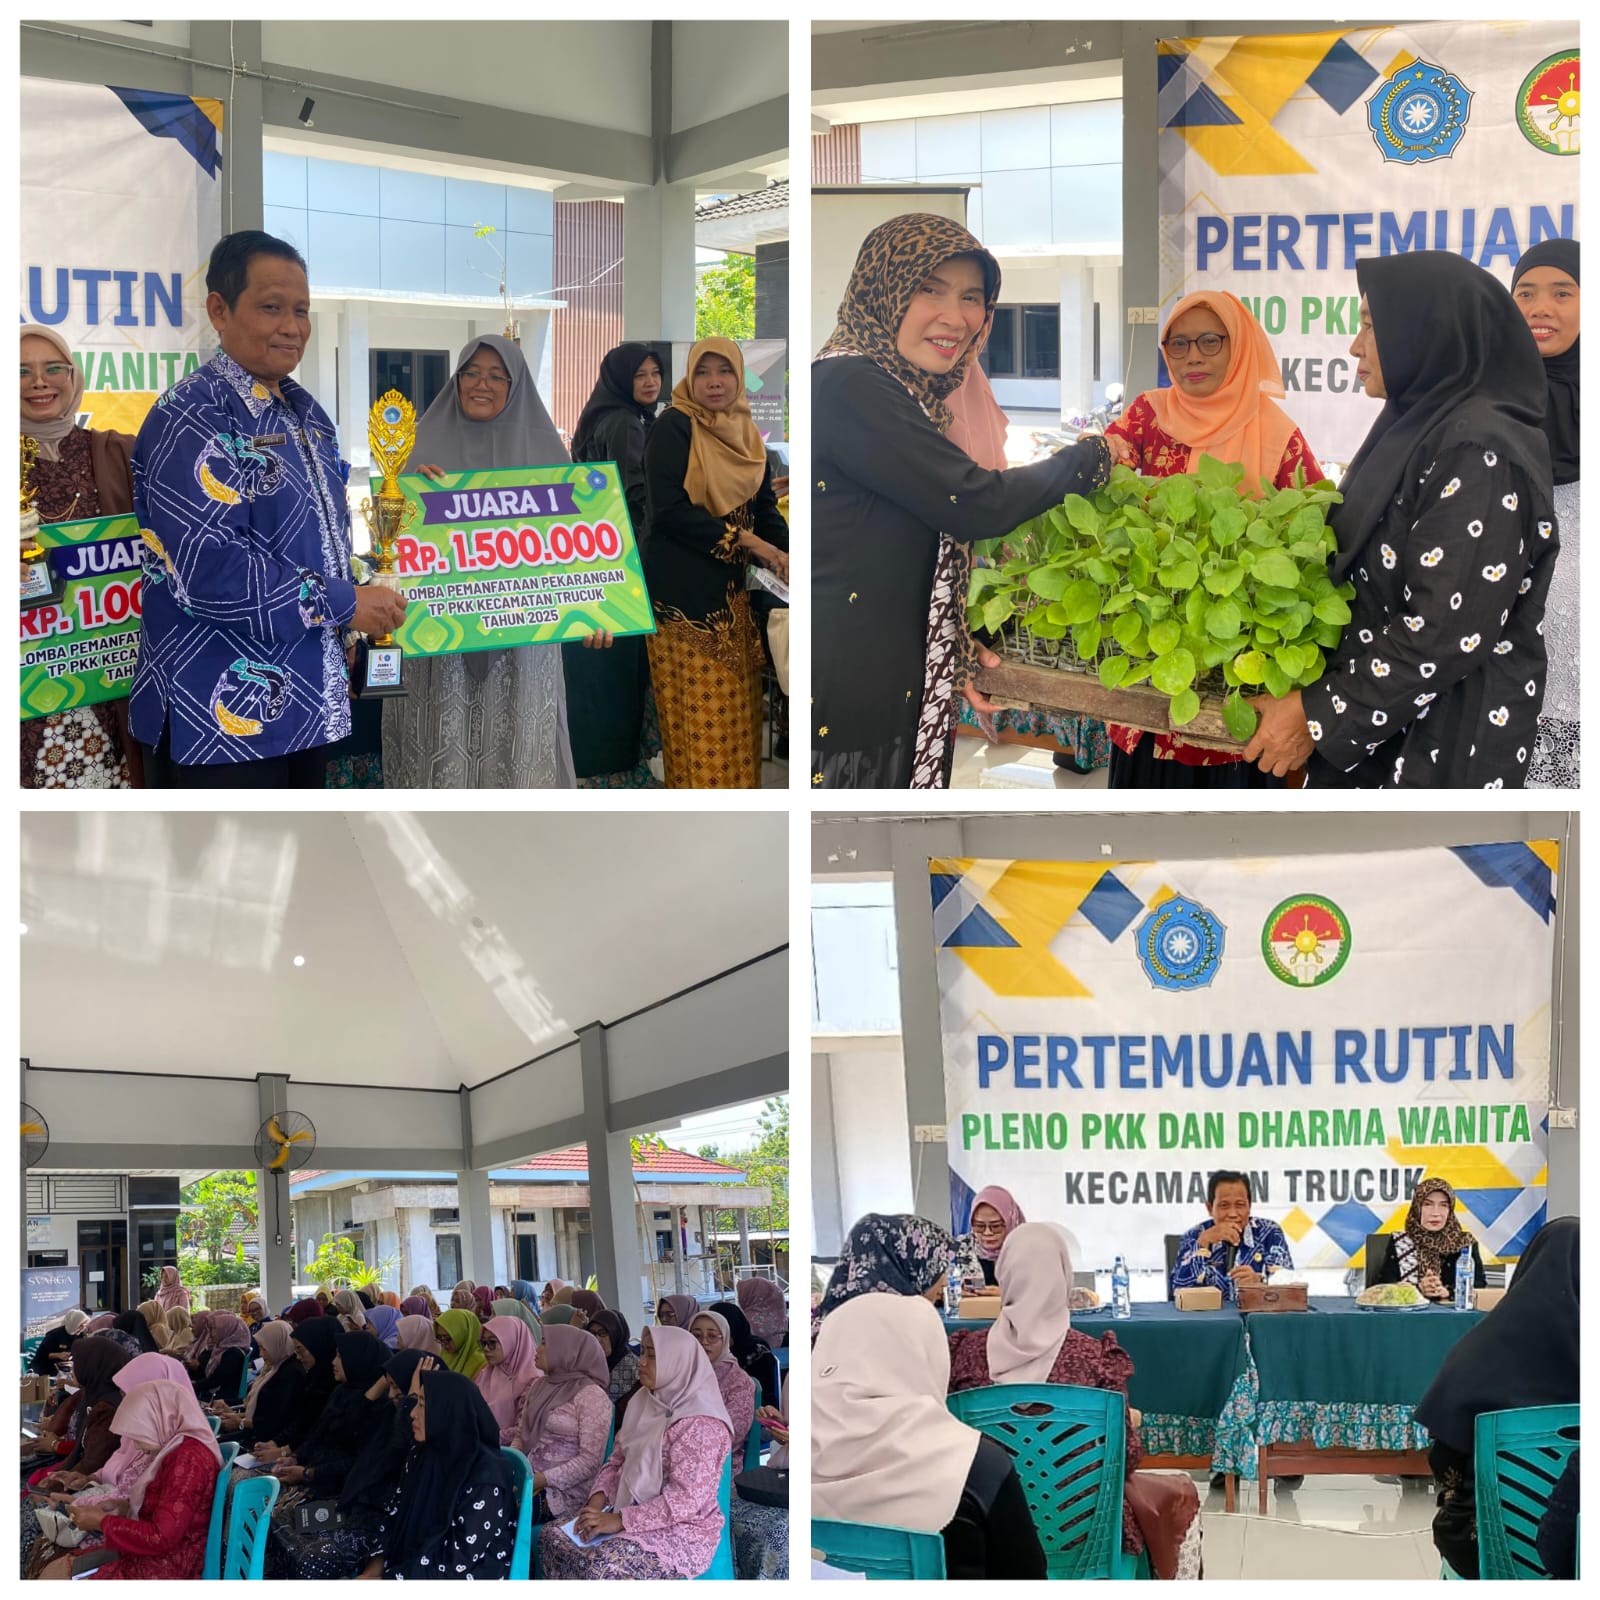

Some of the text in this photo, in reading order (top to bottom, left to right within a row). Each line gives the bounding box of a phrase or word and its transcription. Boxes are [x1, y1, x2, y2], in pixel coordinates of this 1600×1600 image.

[1196, 204, 1574, 271] PERTEMUAN
[20, 266, 182, 327] UTIN
[444, 489, 540, 519] JUARA
[66, 540, 146, 576] JUAR
[452, 522, 618, 569] 1.500.000
[401, 570, 625, 601] LOMBA PEMANFATAAN PEKARANGAN
[428, 588, 605, 616] TP PKK KECAMATAN TRUCUK
[482, 609, 559, 629] TAHUN 2025
[70, 631, 141, 657] PEMANFAT
[48, 649, 138, 677] TP PKK KECA
[106, 663, 137, 681] TAH
[977, 1024, 1514, 1089] PERTEMUAN RUTIN
[961, 1105, 1531, 1151] PLENO PKK DAN DHARMA WANITA
[1065, 1168, 1424, 1205] KECAMAN TRUCUK
